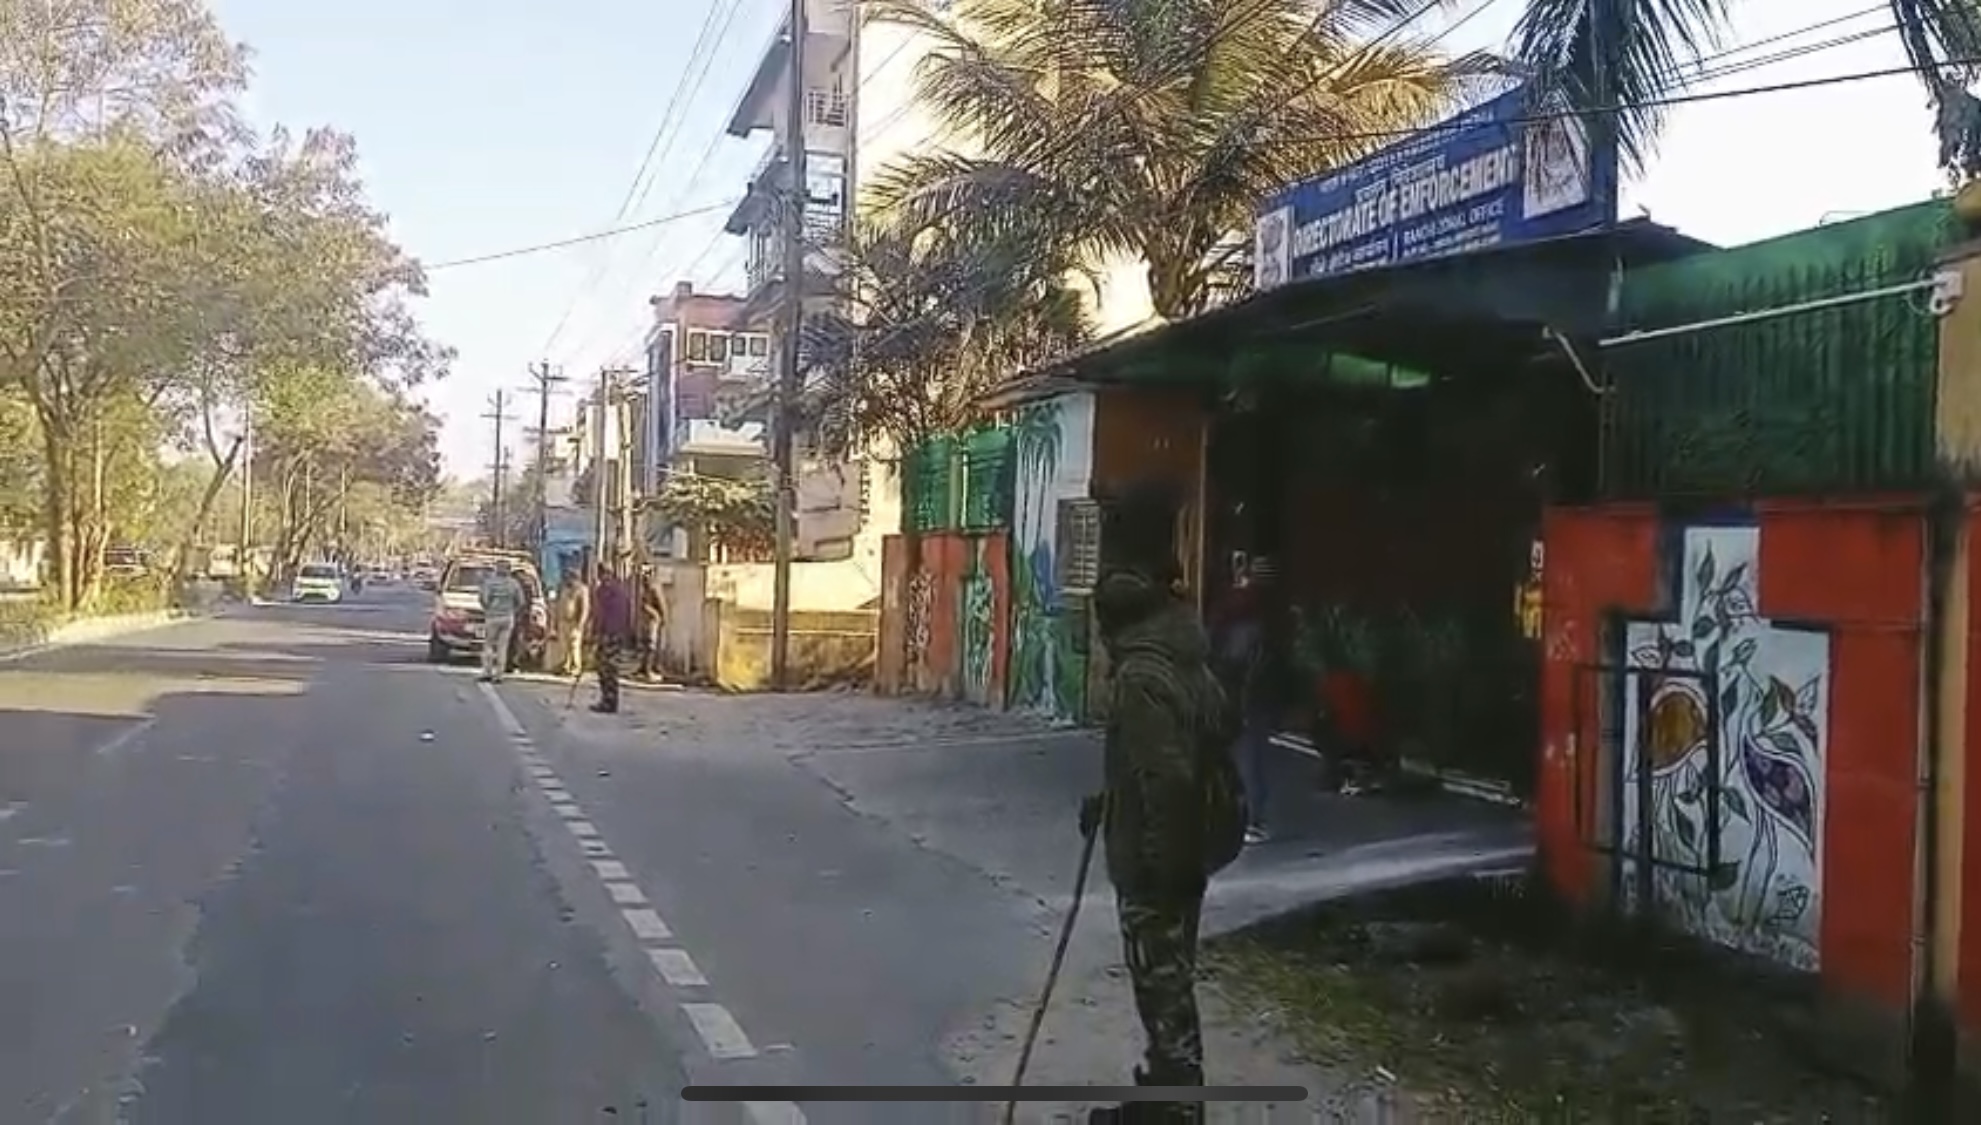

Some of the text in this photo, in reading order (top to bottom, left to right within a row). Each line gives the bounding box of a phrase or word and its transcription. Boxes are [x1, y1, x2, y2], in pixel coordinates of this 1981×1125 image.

[1294, 198, 1378, 258] DIRECTORATE
[1378, 189, 1398, 226] OF
[1399, 144, 1519, 220] ENFORCEMENT
[1469, 198, 1504, 224] OFFICE
